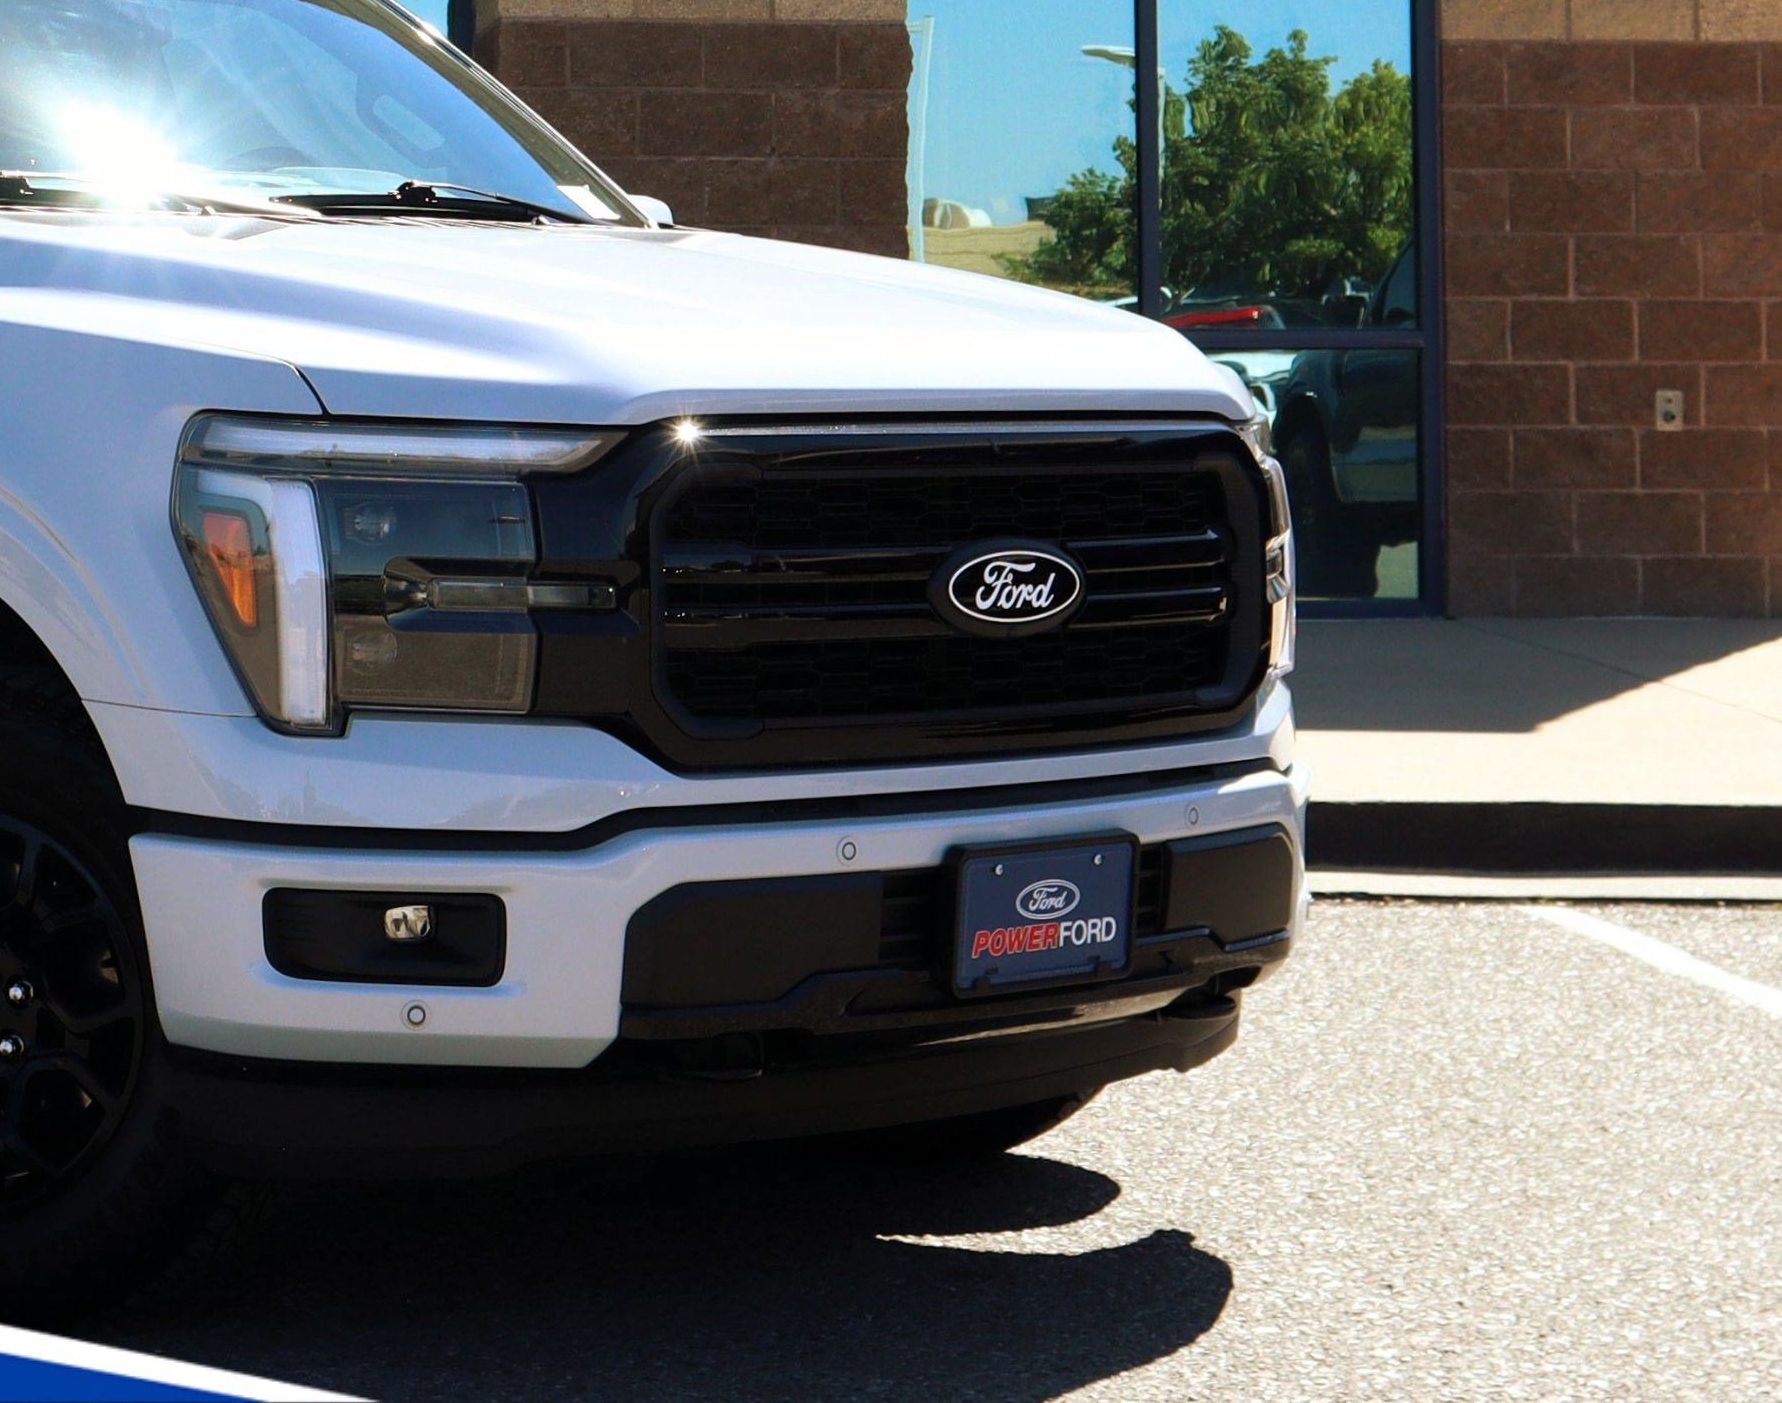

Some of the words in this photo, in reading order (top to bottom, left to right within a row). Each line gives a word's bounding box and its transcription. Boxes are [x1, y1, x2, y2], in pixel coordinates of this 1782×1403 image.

[975, 561, 1056, 610] Ford
[1028, 887, 1068, 912] Ford
[971, 916, 1117, 959] POWERFORD
